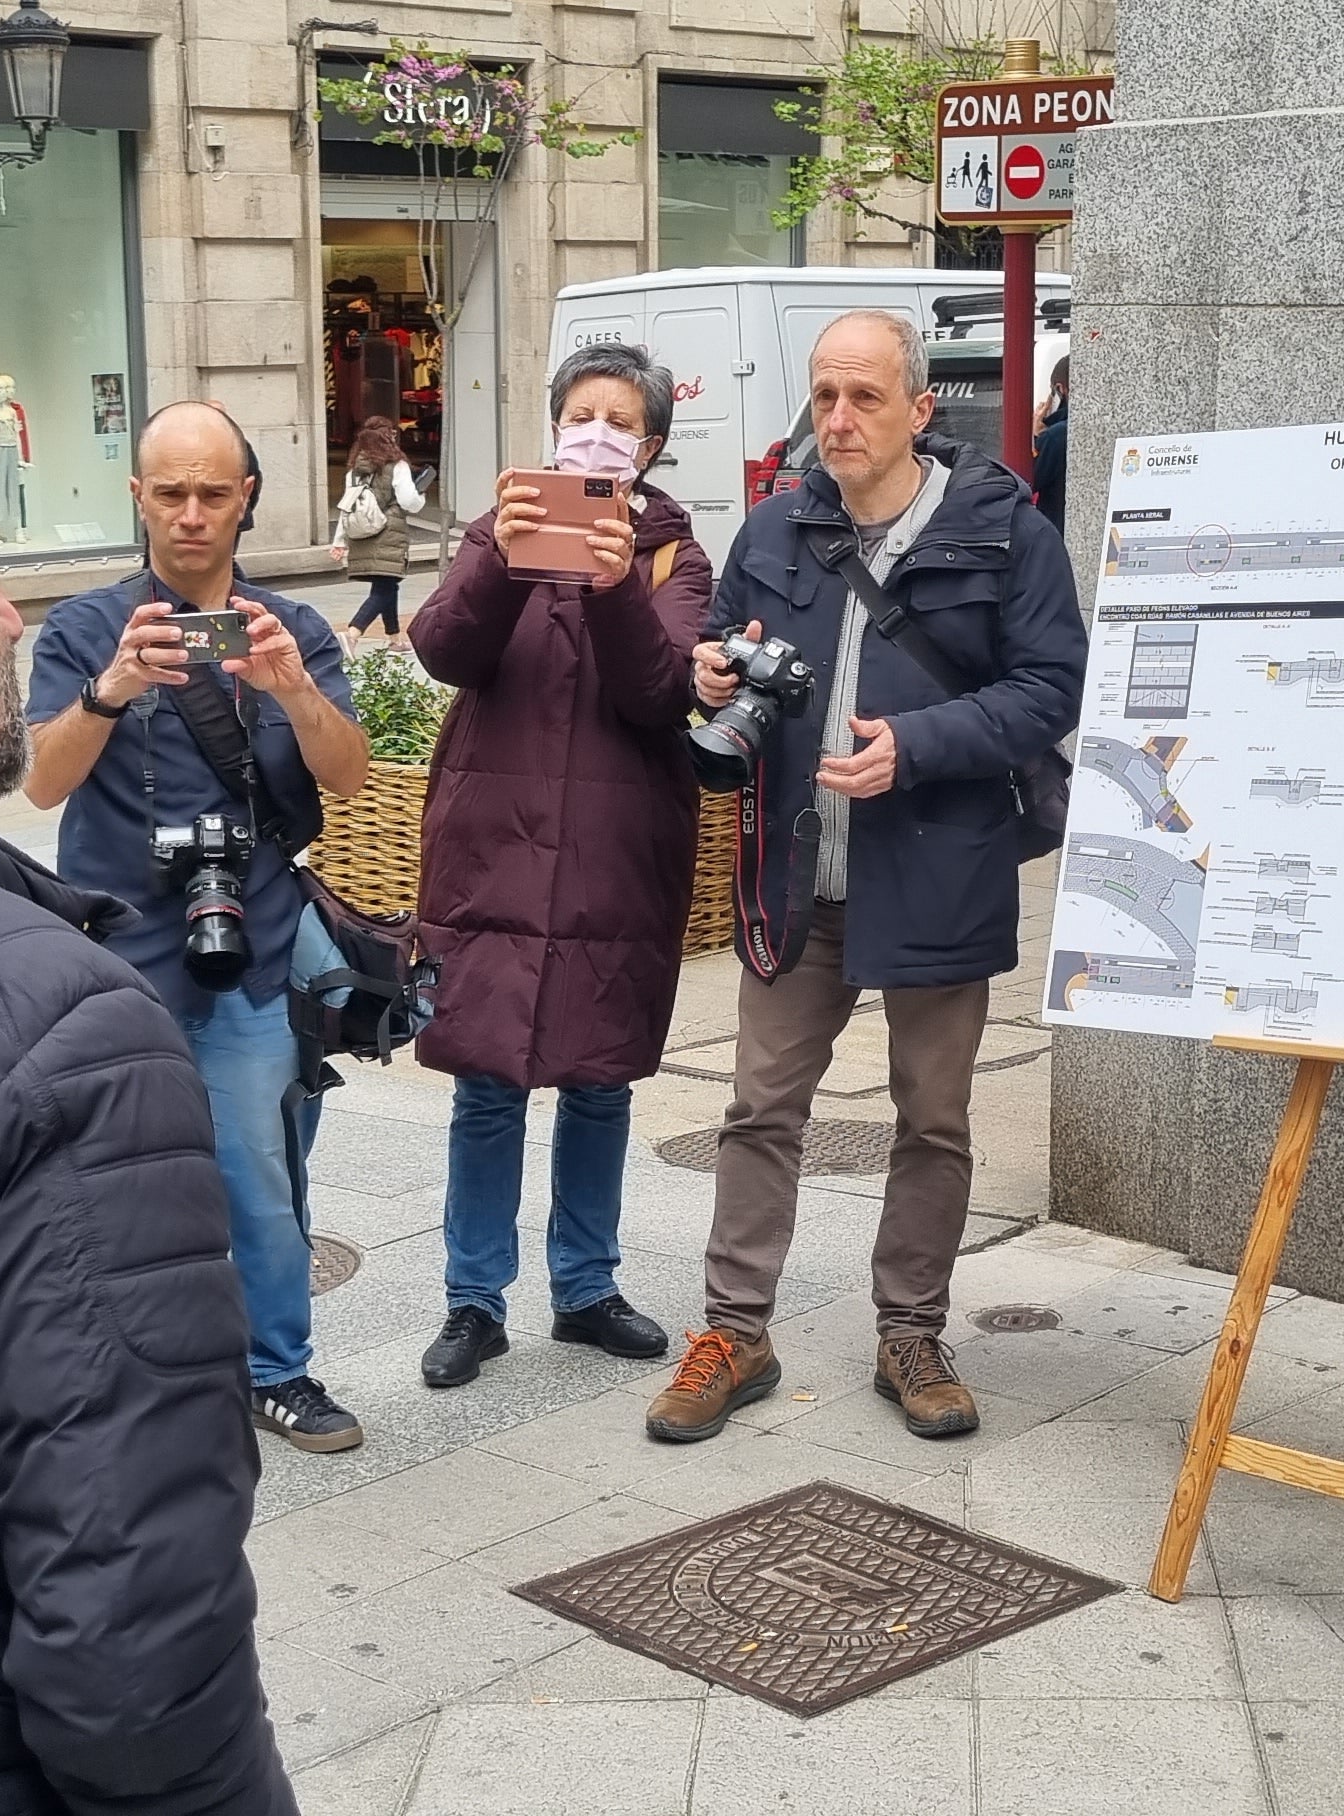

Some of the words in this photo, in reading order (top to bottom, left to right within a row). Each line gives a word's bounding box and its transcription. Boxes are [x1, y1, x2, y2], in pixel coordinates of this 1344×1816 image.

[943, 94, 1022, 127] ZONA
[1034, 89, 1115, 124] PEON
[1058, 143, 1074, 154] AG
[669, 429, 710, 441] OURENSE
[1148, 445, 1181, 454] Concello
[1183, 444, 1193, 452] de
[1147, 454, 1199, 467] OURENSE
[743, 777, 755, 794] 7
[743, 797, 755, 835] EOS
[752, 925, 773, 973] Canon
